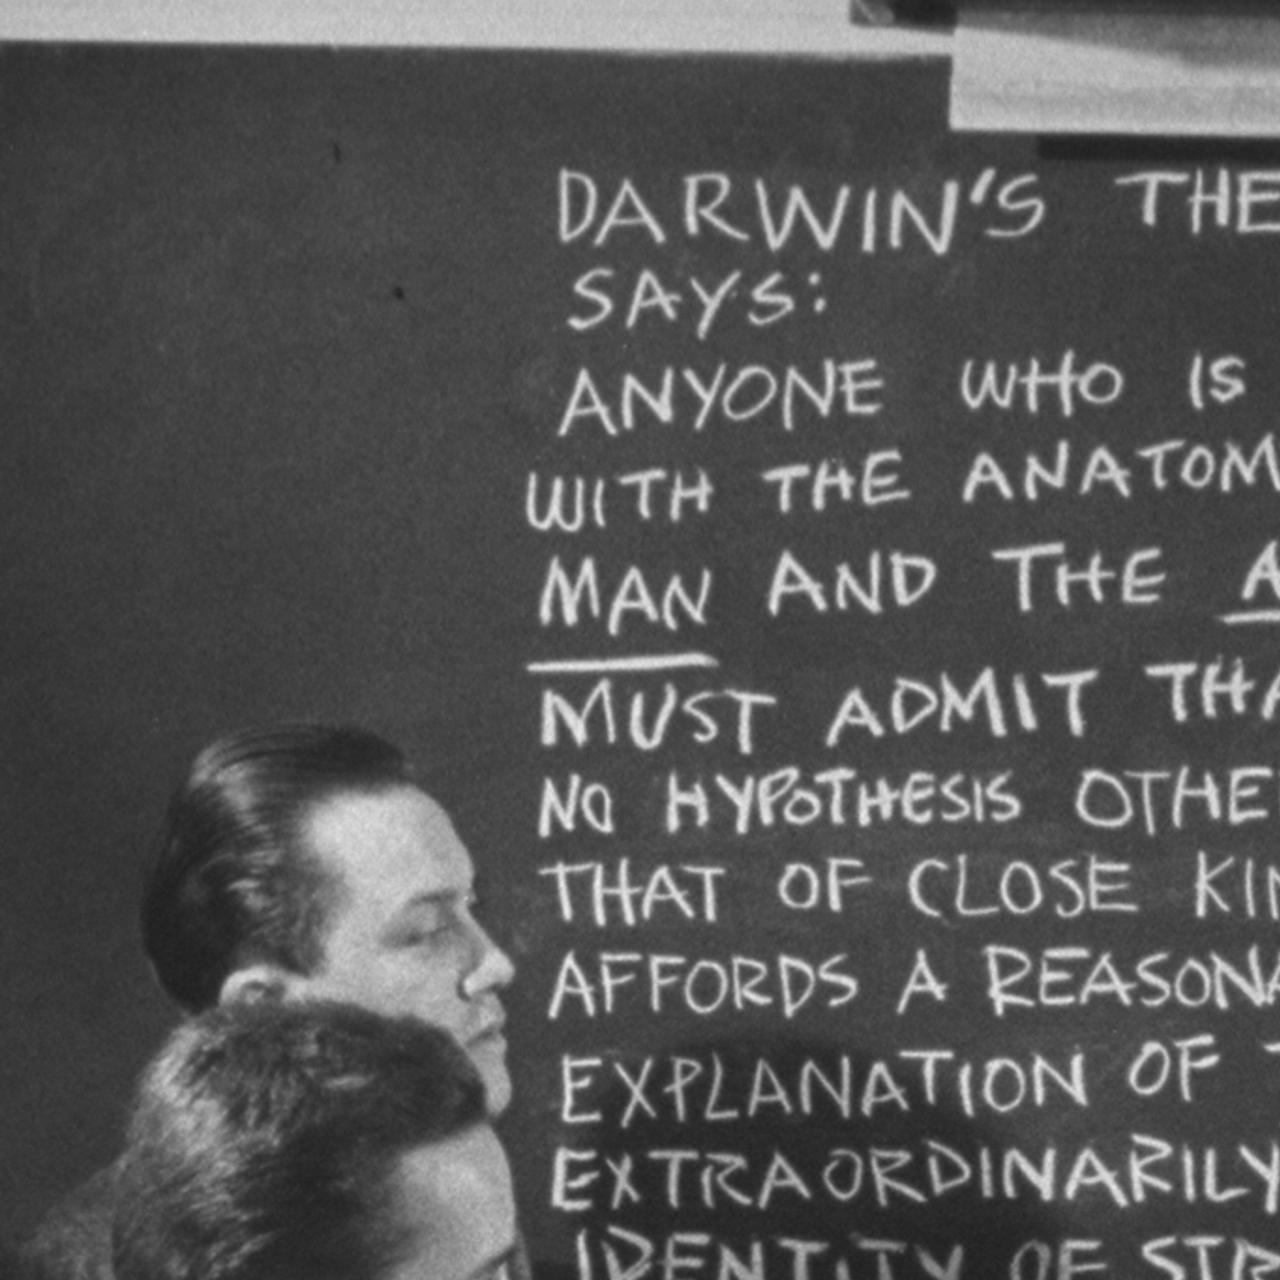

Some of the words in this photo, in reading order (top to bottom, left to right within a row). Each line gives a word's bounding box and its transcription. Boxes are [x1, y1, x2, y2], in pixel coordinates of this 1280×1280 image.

[558, 168, 1045, 256] DARWIN'S
[567, 267, 826, 340] SAYS:
[557, 358, 884, 437] ANYONE
[960, 349, 1124, 418] WHO
[1188, 354, 1246, 410] IS
[525, 468, 713, 533] WITH
[762, 449, 910, 513] THE
[538, 556, 712, 636] MAN
[767, 550, 937, 616] AND
[991, 541, 1166, 612] THE
[540, 678, 777, 755] MUST
[825, 667, 1098, 747] ADMIT
[538, 773, 614, 838] NO
[666, 766, 1022, 835] HYPOTHESIS
[539, 857, 725, 927] THAT
[777, 856, 871, 913] OF
[907, 853, 1139, 919] CLOSE
[547, 950, 859, 1020] AFFORDS
[896, 948, 948, 1014] A
[560, 1049, 1089, 1128] EXPLANATION
[1127, 1033, 1220, 1102] OF
